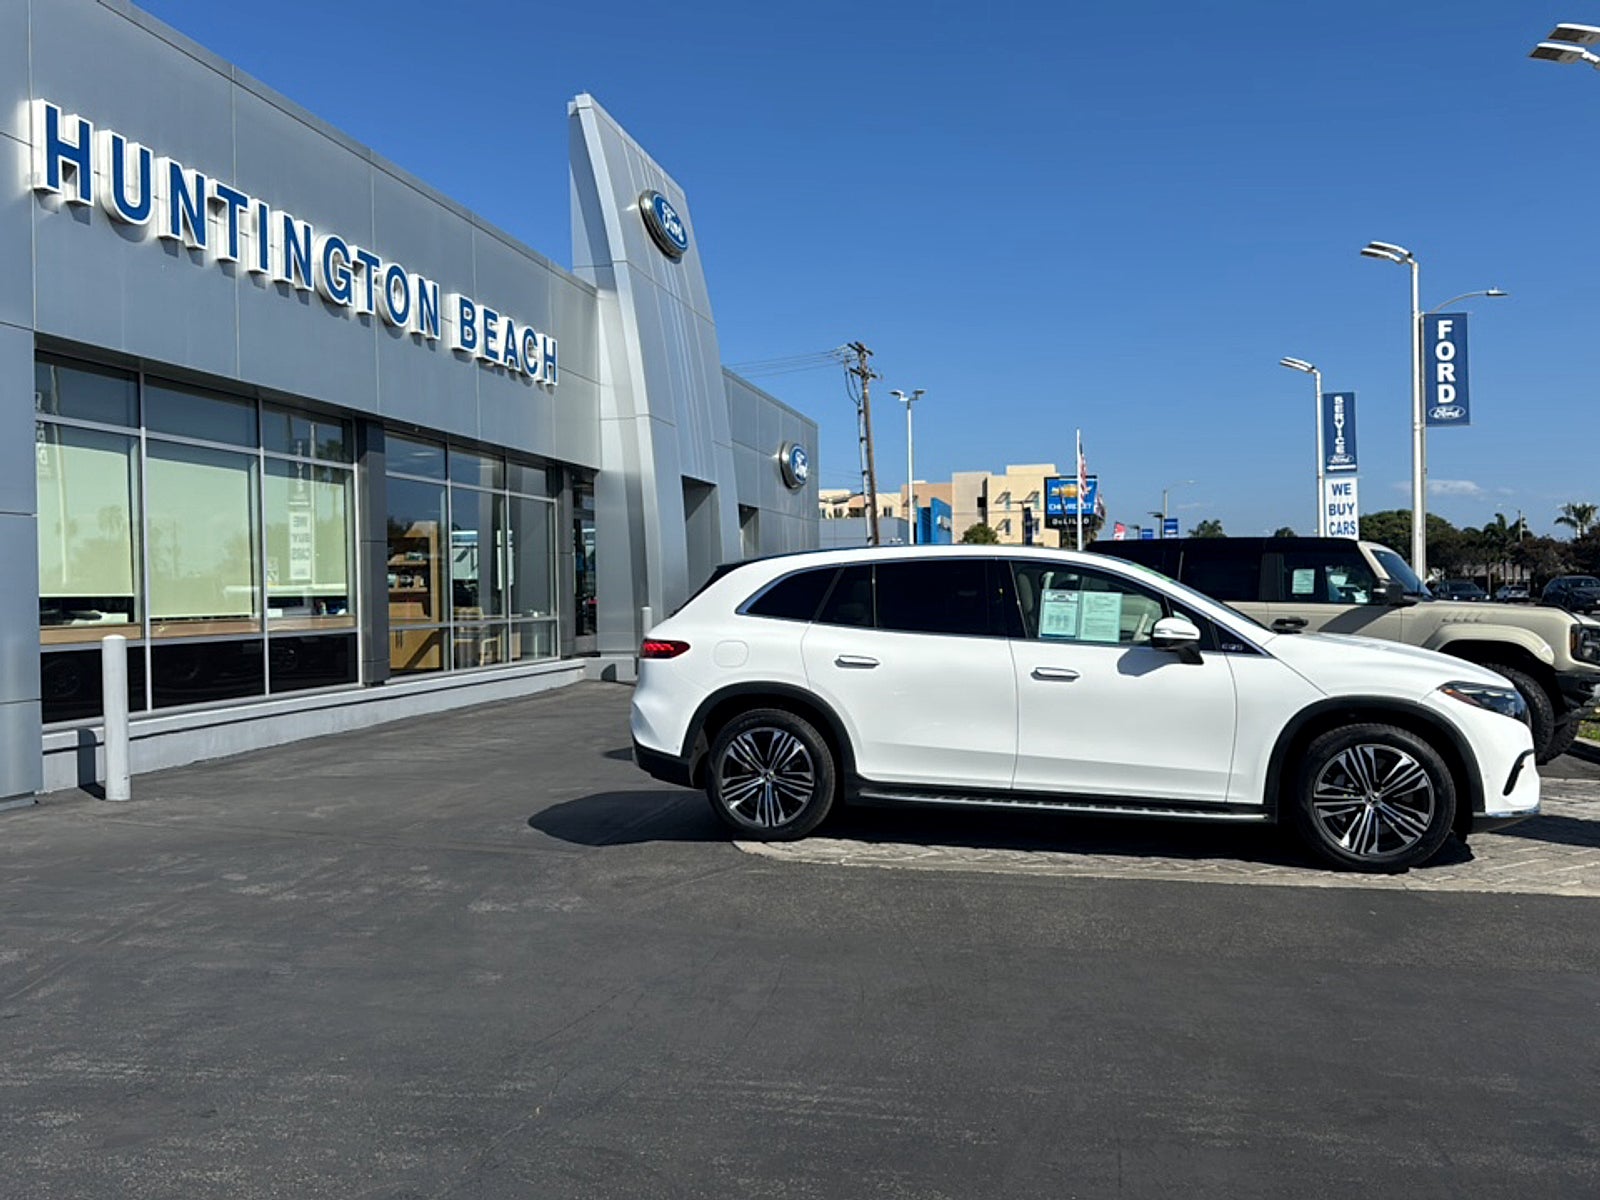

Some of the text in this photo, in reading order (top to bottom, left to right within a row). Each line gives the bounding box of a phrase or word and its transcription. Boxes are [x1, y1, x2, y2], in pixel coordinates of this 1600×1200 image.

[660, 200, 685, 243] Ford
[38, 100, 558, 385] HUNTINGTON BEACH
[1434, 319, 1457, 404] FORD
[1333, 395, 1346, 455] SERVICE
[1432, 406, 1462, 419] Ford
[1331, 483, 1352, 496] WE
[1328, 503, 1355, 517] BUY
[1328, 521, 1357, 537] CARS
